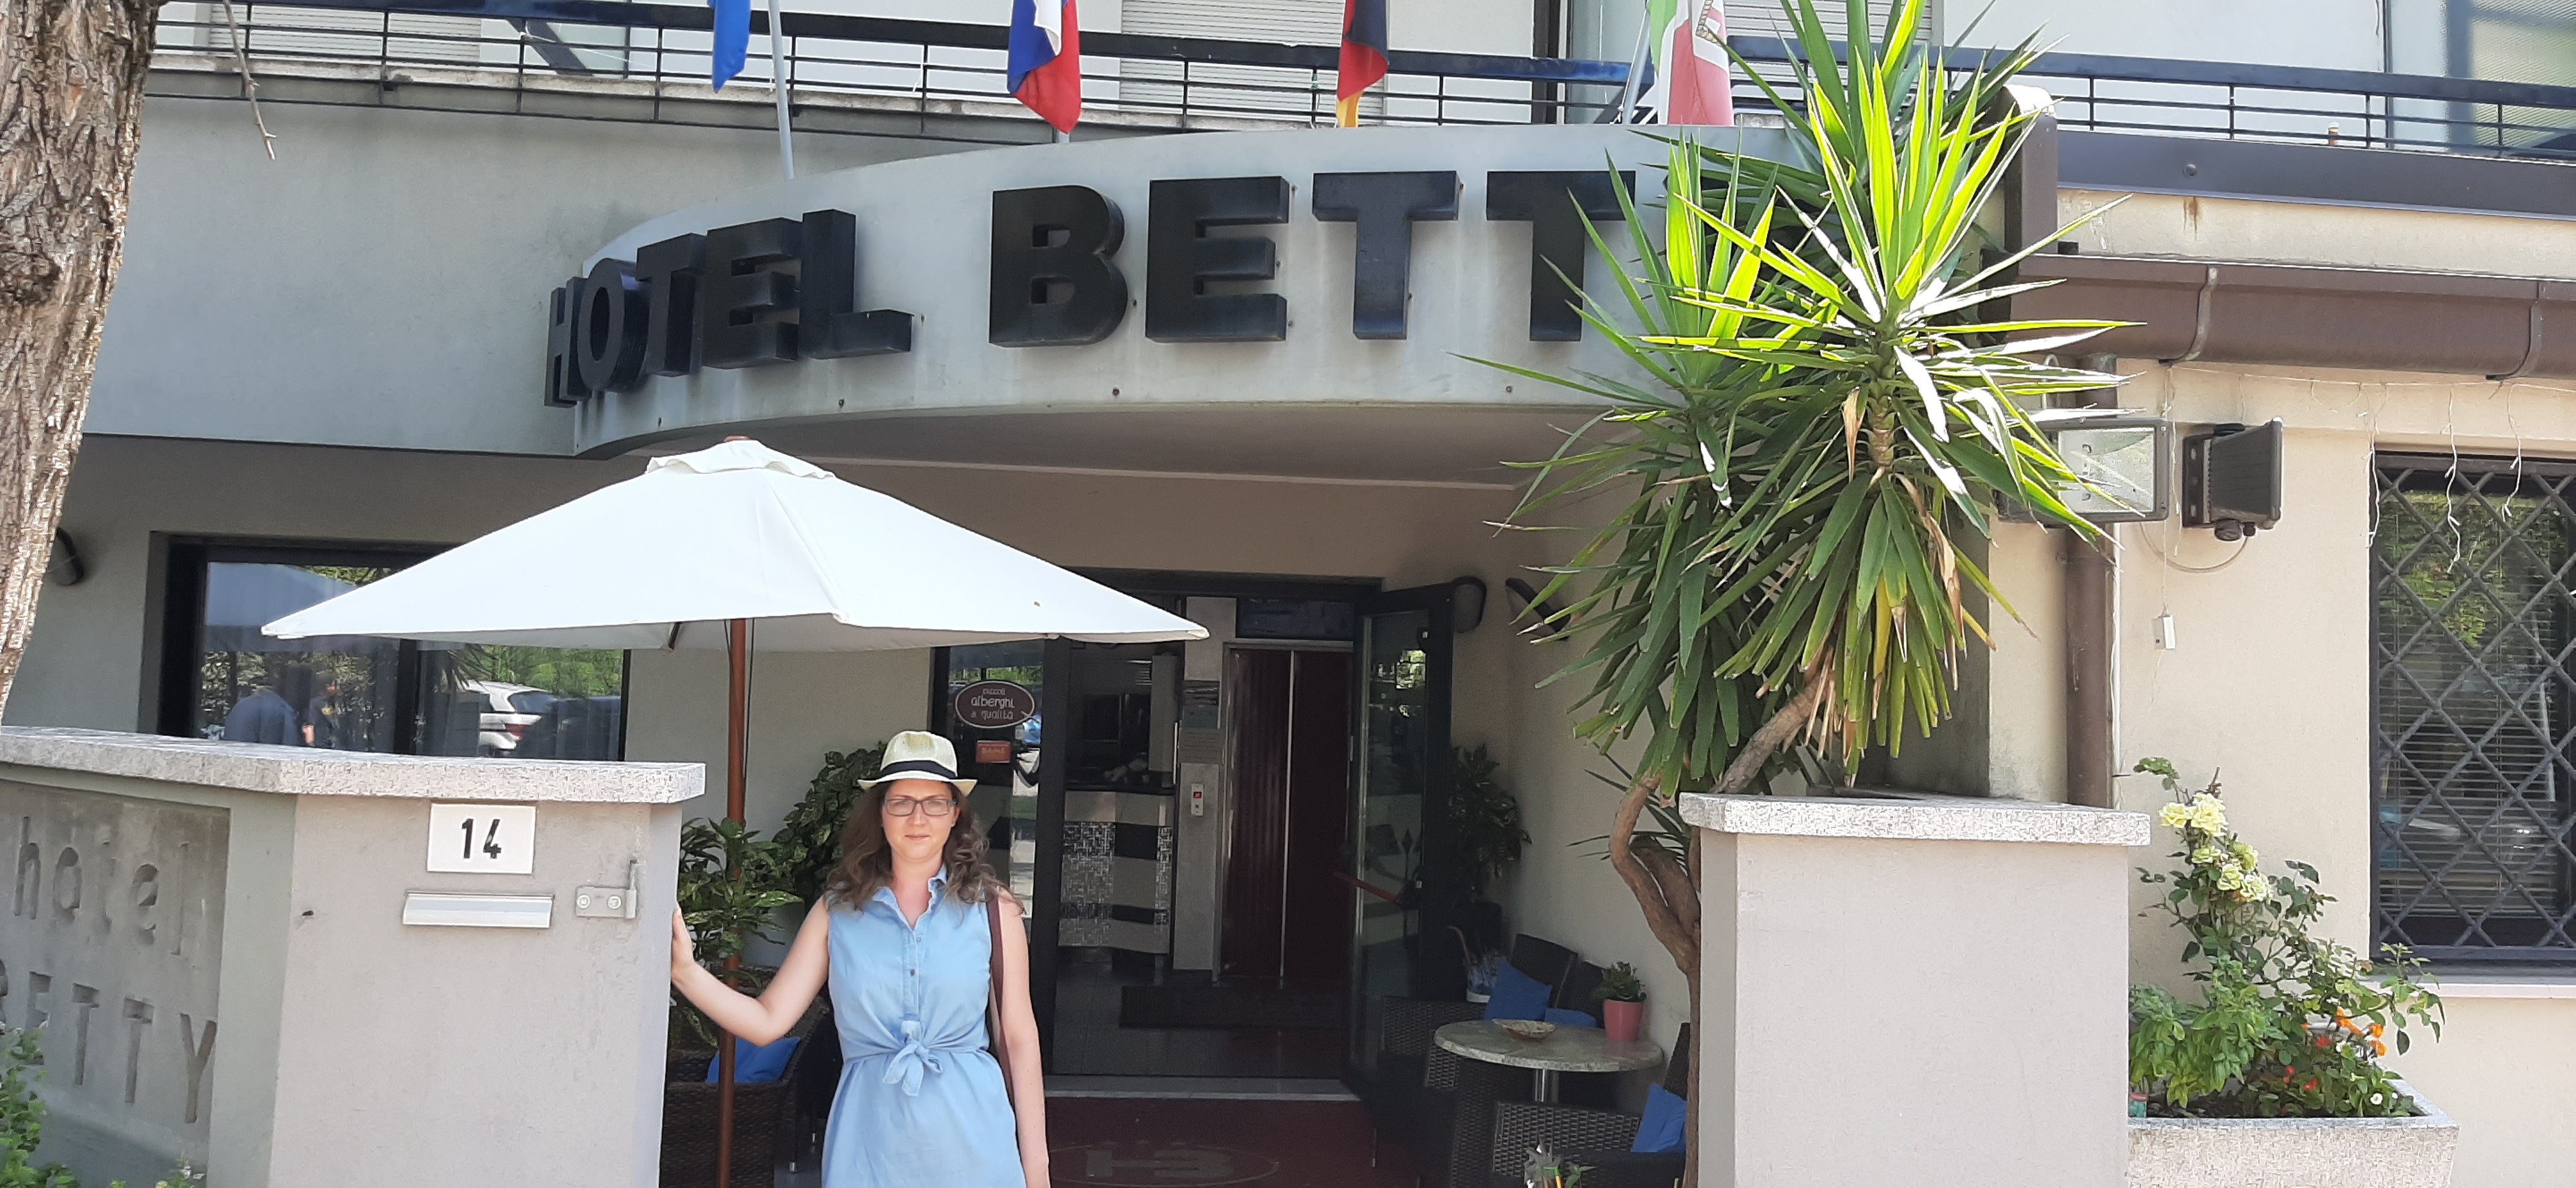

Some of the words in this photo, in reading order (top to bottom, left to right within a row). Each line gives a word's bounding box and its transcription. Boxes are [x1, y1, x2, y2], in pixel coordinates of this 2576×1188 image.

[544, 209, 914, 407] HOTEL
[988, 170, 1637, 348] BETT
[970, 694, 1016, 710] alberghi
[461, 818, 502, 860] 14
